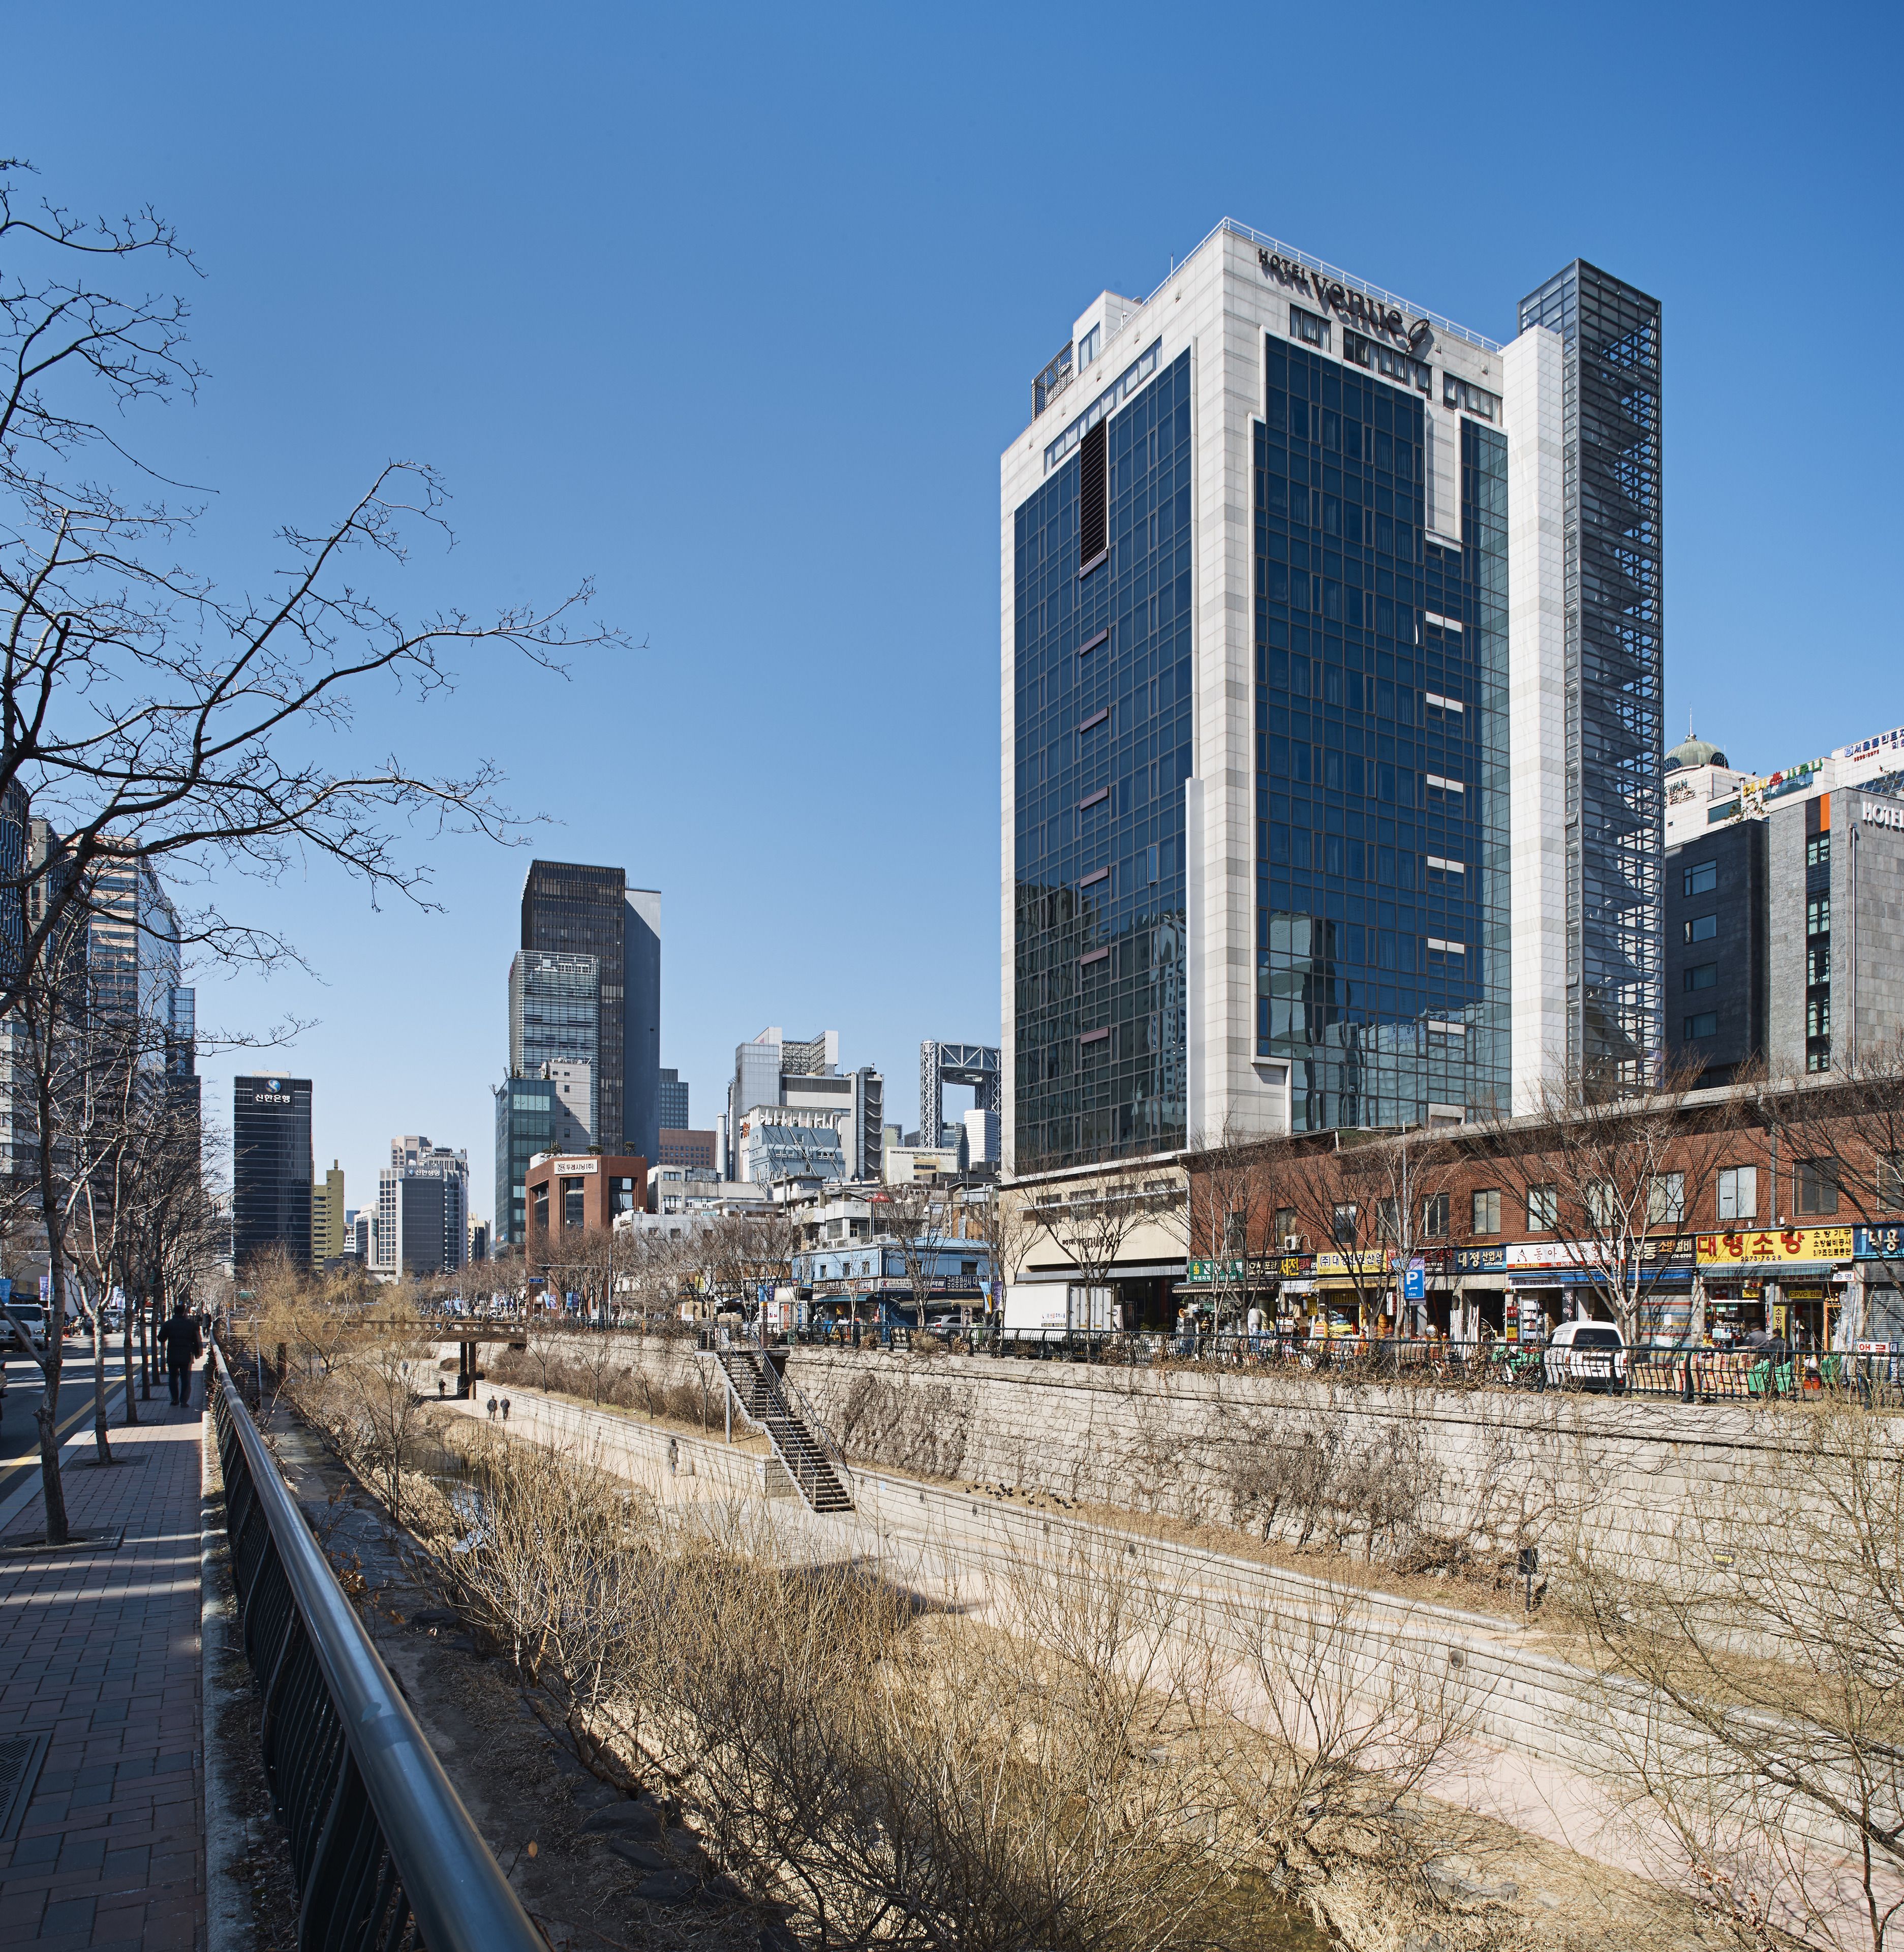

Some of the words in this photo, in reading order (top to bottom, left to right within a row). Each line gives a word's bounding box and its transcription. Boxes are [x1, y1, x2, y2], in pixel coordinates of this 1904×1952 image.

[1258, 248, 1308, 285] HOTEL
[255, 1094, 290, 1103] 신한은행
[1814, 1229, 1851, 1238] 소방기구
[1697, 1231, 1805, 1257] 대영소방
[1458, 1252, 1480, 1268] 대정
[1481, 1250, 1503, 1262] 산업사
[947, 1276, 972, 1288] 금성종합상사
[1406, 1271, 1418, 1285] P
